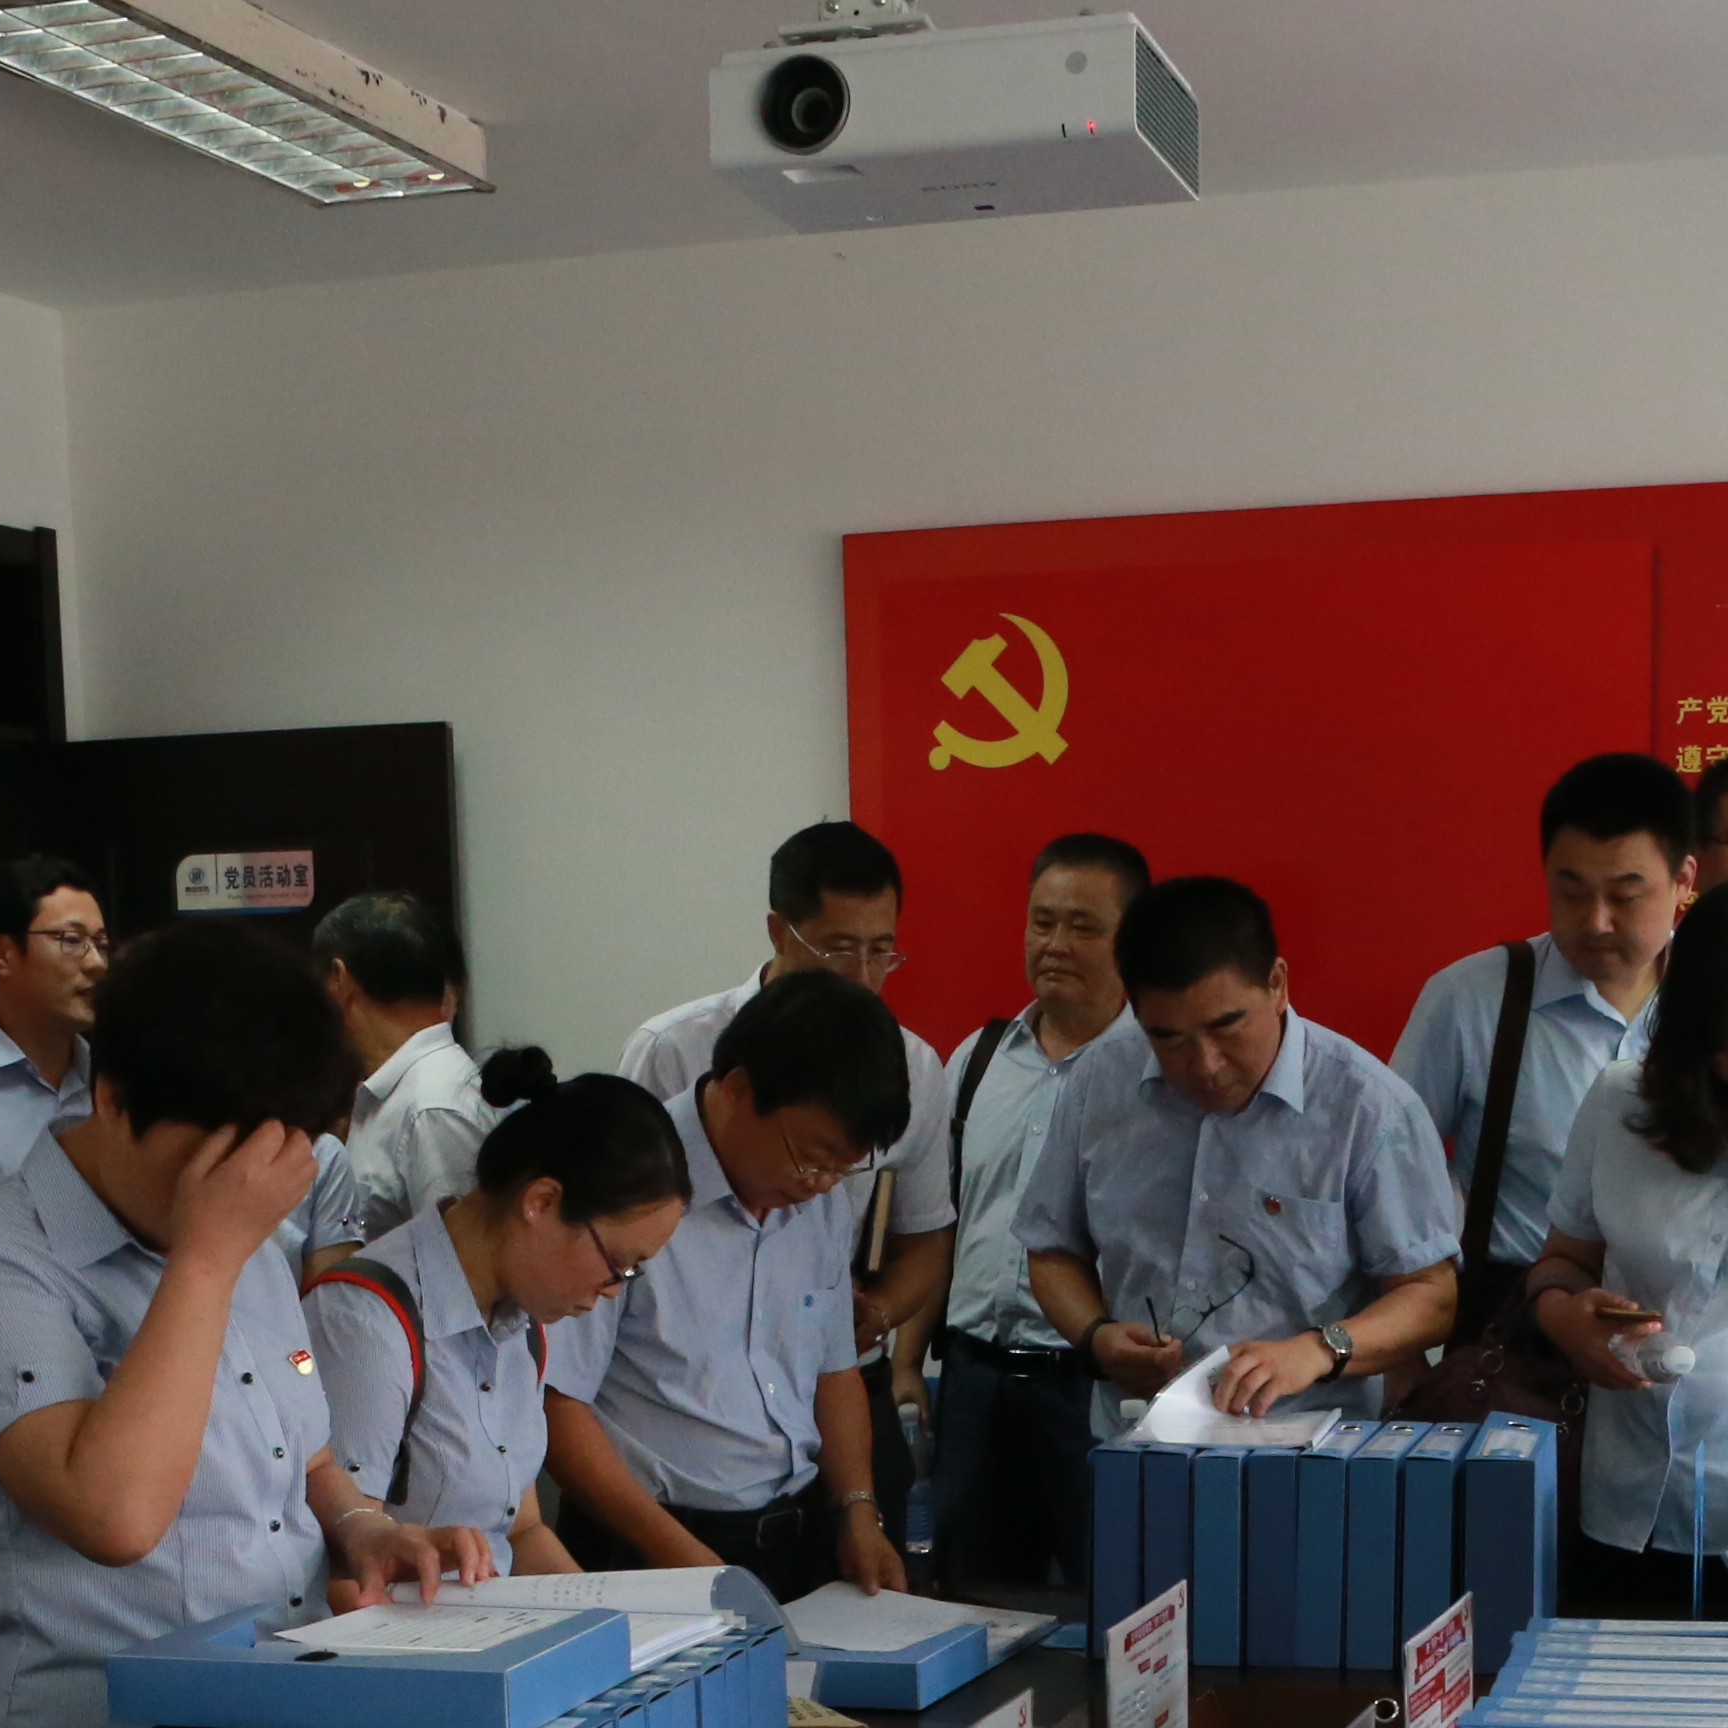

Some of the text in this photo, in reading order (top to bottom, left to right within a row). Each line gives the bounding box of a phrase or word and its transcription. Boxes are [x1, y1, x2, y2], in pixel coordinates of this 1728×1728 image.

[224, 864, 310, 890] 党员活动室
